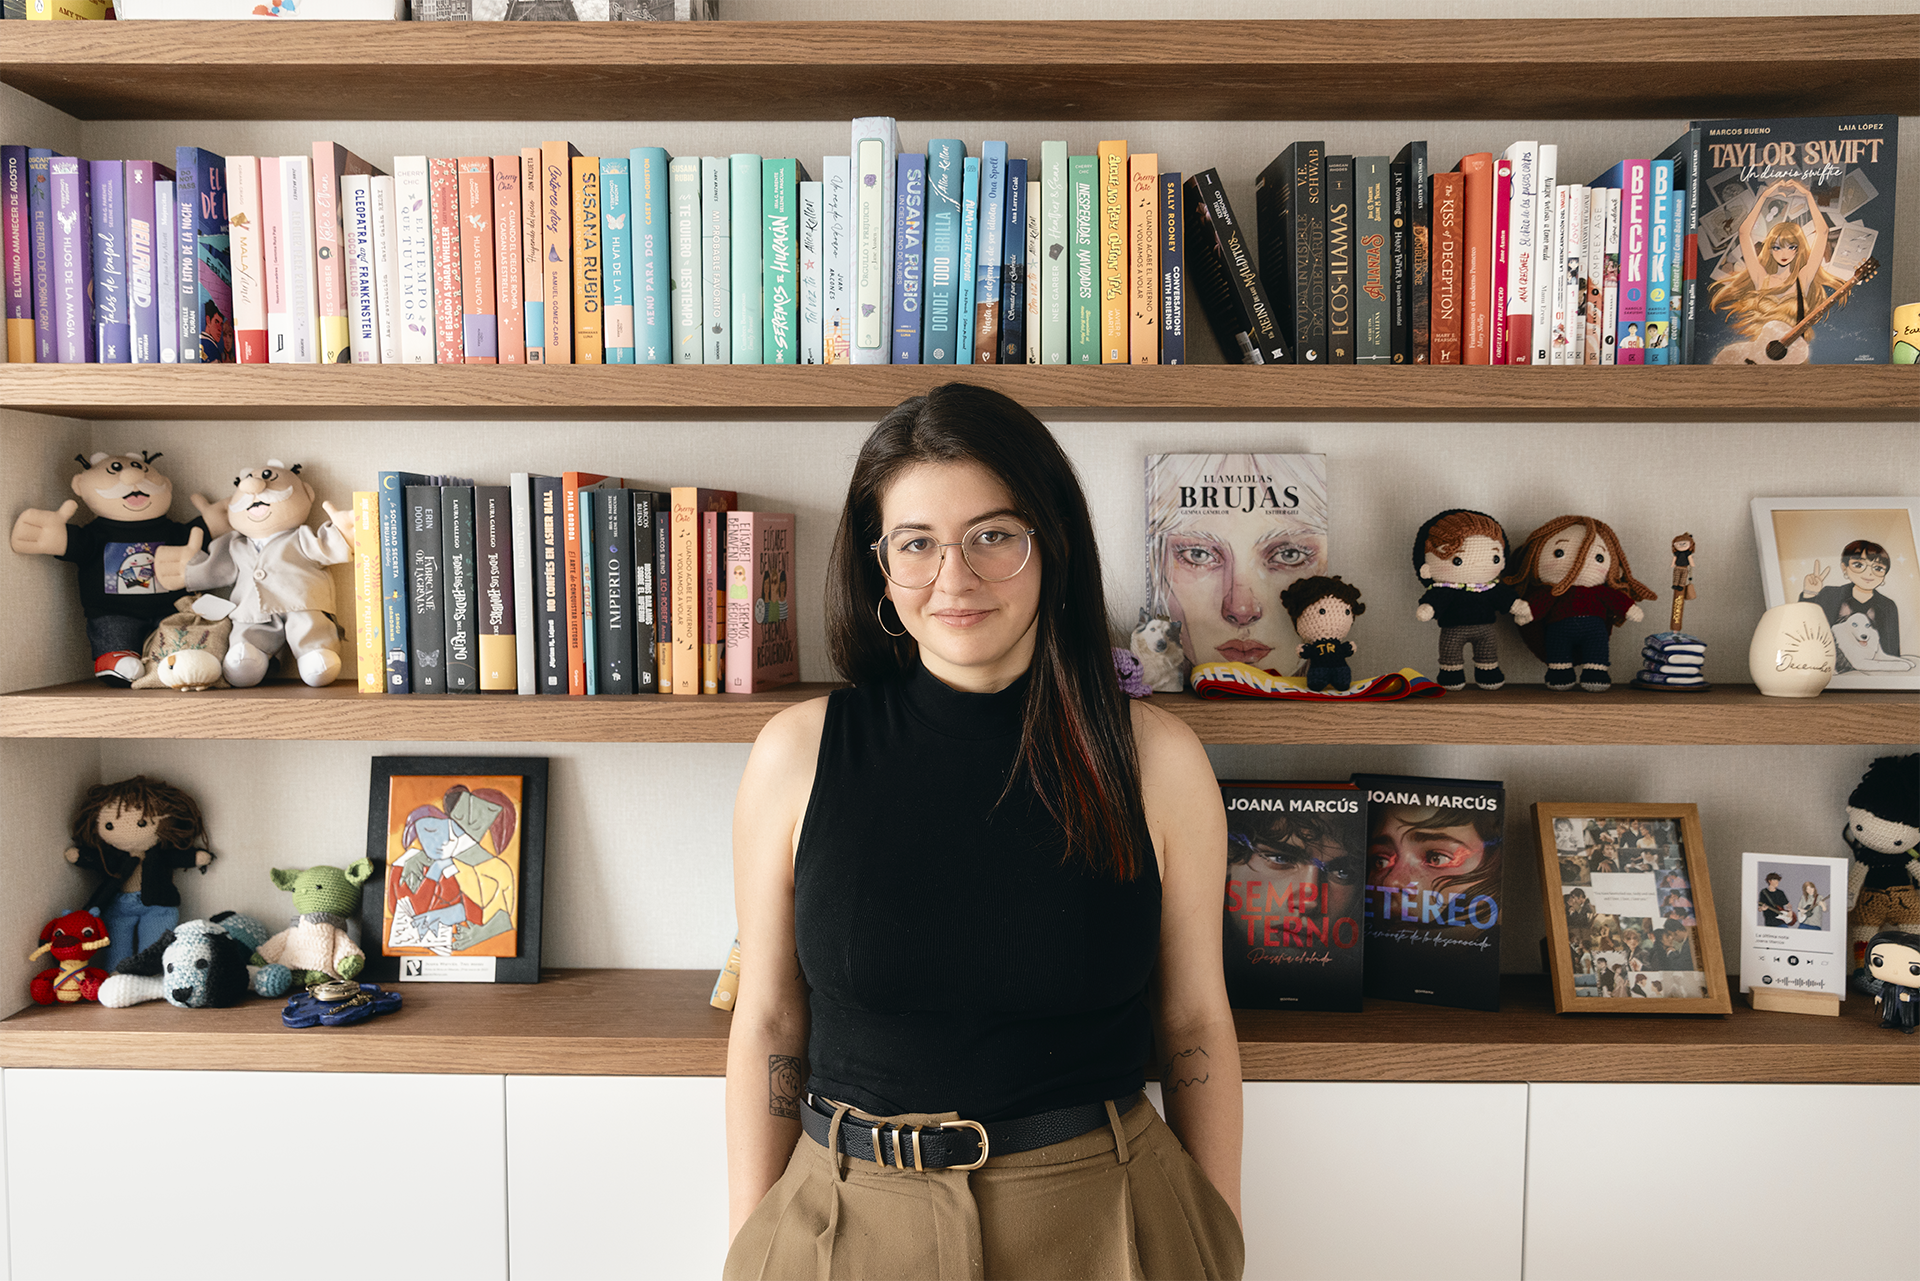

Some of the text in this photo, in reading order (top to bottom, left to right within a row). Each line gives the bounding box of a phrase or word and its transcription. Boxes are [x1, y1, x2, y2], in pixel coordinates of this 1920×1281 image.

[9, 158, 18, 192] AGOSTO
[1309, 149, 1318, 203] SCHWAB
[1708, 139, 1883, 168] TAYLOR SWIFT
[1740, 163, 1842, 185] Un diario swiftie
[11, 194, 19, 205] DE
[547, 165, 562, 234] Catorce días
[1167, 182, 1175, 210] SALLY
[1440, 200, 1454, 227] KISS
[11, 207, 20, 253] AMANECER
[442, 227, 450, 263] WHEELER
[582, 172, 598, 313] SUSANA RUBIO
[903, 169, 921, 312] SUSANA RUBIO
[1078, 183, 1091, 298] INESPERADAS NAVIDADES
[1443, 230, 1452, 238] of
[1591, 207, 1602, 286] COMPLEX AGE
[1627, 166, 1643, 282] BECK
[1651, 166, 1668, 283] BECK
[12, 255, 21, 285] ÚLTIMO
[35, 211, 49, 331] EL RETRATO DE DORIAN GRAY
[131, 218, 151, 308] HELLFRIEND
[181, 203, 193, 294] EL RITMO DE LA NOCHE
[348, 233, 358, 297] COCO MELLORS
[355, 189, 371, 339] CLEOPATRA and FRANKENSTEIN
[402, 207, 414, 320] QUE TUVIMOS
[415, 218, 427, 309] EL TIEMPO
[612, 237, 621, 292] HIJA DE LA
[712, 211, 721, 317] MI PROBABLE FAVORITO
[1361, 234, 1386, 301] ALIANZAS
[14, 288, 21, 297] EL
[63, 237, 75, 338] HIJOS DE LA MAGIA
[475, 278, 483, 304] NUEVO
[511, 275, 517, 283] SE
[645, 234, 654, 325] MENÚ PARA DOS
[932, 213, 951, 331] DONDE TODO BRILLA
[1441, 241, 1454, 319] DECEPTION
[444, 299, 452, 329] BESADO
[552, 301, 560, 346] GÓMEZ-CARO
[1173, 266, 1181, 336] CONVERSATIONS
[445, 332, 452, 342] HE
[1179, 486, 1299, 513] BRUJAS
[1204, 475, 1272, 483] LLAMADLAS
[414, 506, 423, 531] DOOM
[425, 509, 433, 529] ERIN
[516, 505, 526, 568] José Agustín
[728, 518, 739, 562] BENAVENT
[739, 523, 751, 562] ELÍSABET
[424, 556, 437, 611] FABRICANTE
[608, 559, 621, 630] IMPERIO
[728, 603, 738, 648] RECUERDOS
[739, 603, 749, 639] SEREMOS
[1316, 643, 1336, 656] JR
[1228, 797, 1358, 813] JOANA MARCÚS
[1367, 790, 1497, 812] JOANA MARCÚS
[1224, 880, 1328, 914] SEMPI
[1241, 914, 1359, 949] TERNO
